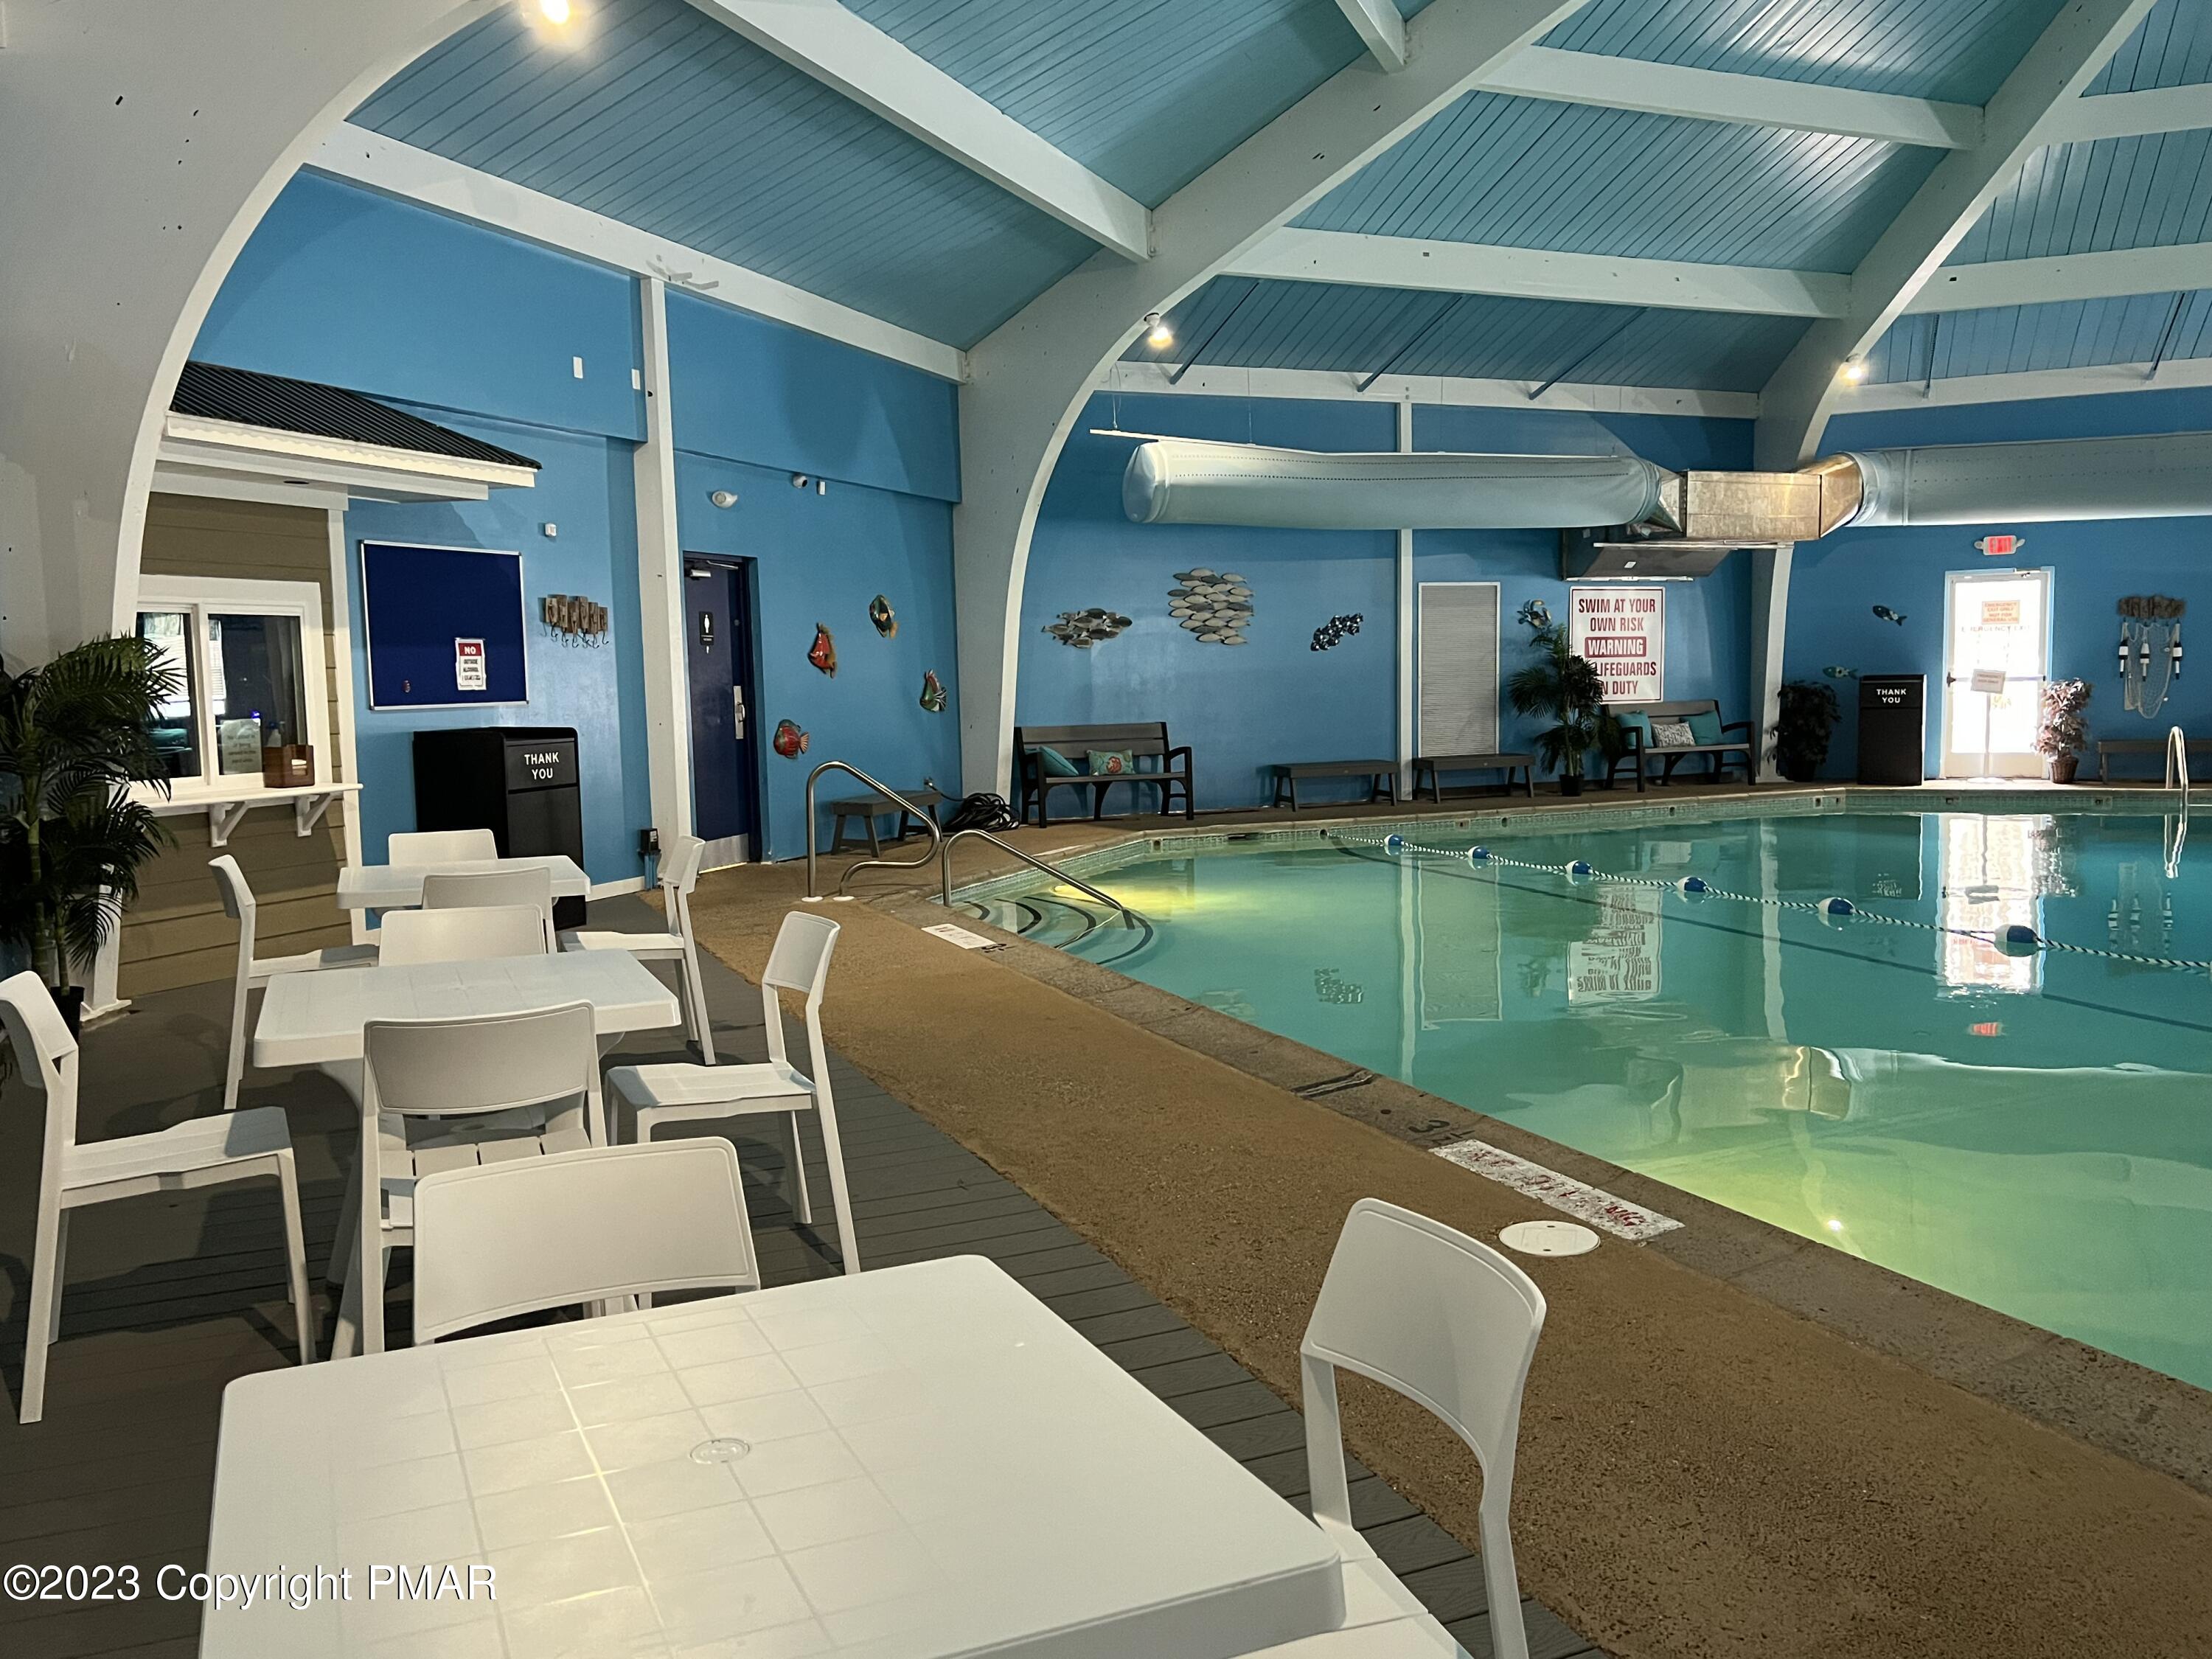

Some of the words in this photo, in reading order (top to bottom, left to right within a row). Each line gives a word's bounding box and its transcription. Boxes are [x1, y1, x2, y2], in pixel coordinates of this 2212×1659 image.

[1578, 598, 1610, 613] SWIM
[1613, 599, 1626, 613] AT
[1630, 598, 1656, 613] YOUR
[1590, 617, 1616, 632] OWN
[1620, 617, 1644, 631] RISK
[464, 646, 477, 655] NO
[1587, 639, 1644, 655] WARNING
[1612, 681, 1638, 695] DUTY
[524, 751, 560, 765] THANK
[531, 767, 553, 780] YOU
